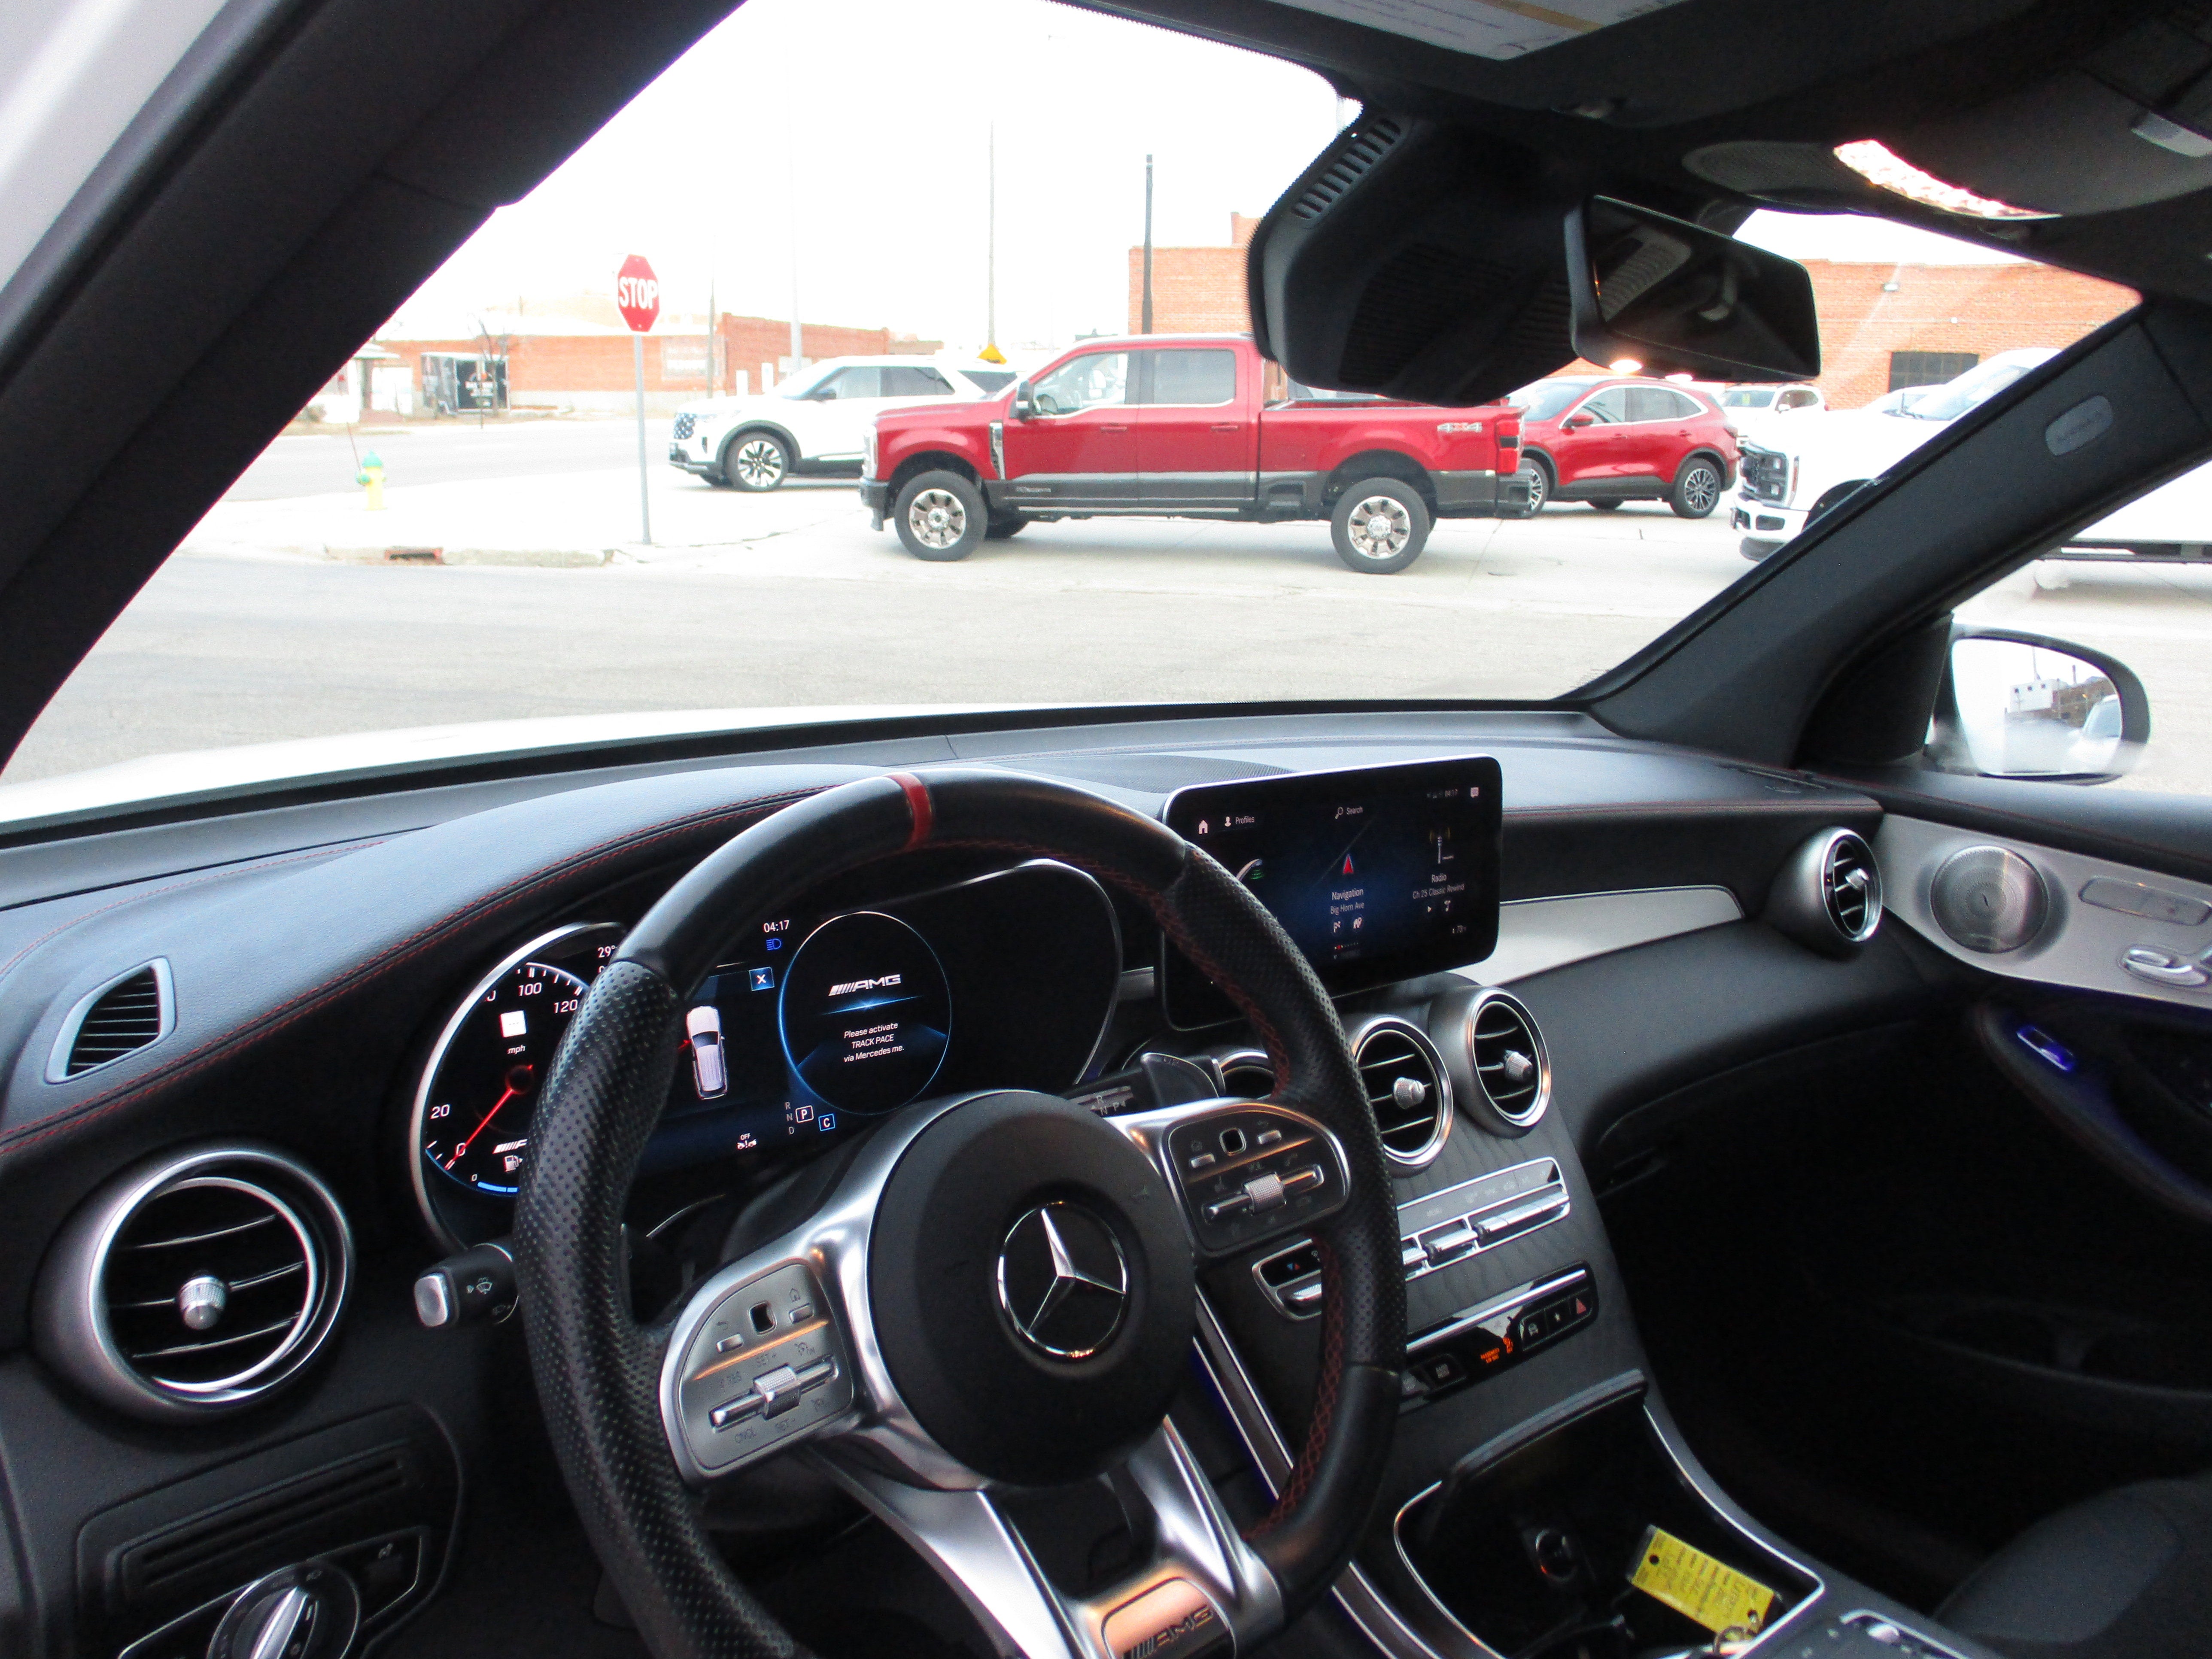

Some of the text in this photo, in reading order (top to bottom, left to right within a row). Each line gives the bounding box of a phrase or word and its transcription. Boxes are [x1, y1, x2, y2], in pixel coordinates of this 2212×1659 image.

[619, 276, 658, 309] STOP
[1347, 806, 1364, 815] Search
[1235, 815, 1255, 825] Profiles
[1432, 873, 1447, 883] Radio
[1332, 888, 1364, 901] Navigation
[1331, 905, 1339, 915] Big
[763, 920, 790, 933] 04:17
[598, 945, 617, 958] 29°
[518, 982, 542, 997] 100
[853, 974, 901, 992] AMG
[553, 999, 578, 1013] 120
[844, 1023, 898, 1039] Please activate
[851, 1034, 894, 1049] TRACK PACE
[507, 1044, 526, 1054] mph
[844, 1045, 905, 1063] via Mercedes me.
[430, 1104, 450, 1119] 20
[785, 1102, 791, 1110] R
[786, 1109, 807, 1121] N P
[788, 1118, 830, 1135] D C
[471, 1174, 477, 1182] 0
